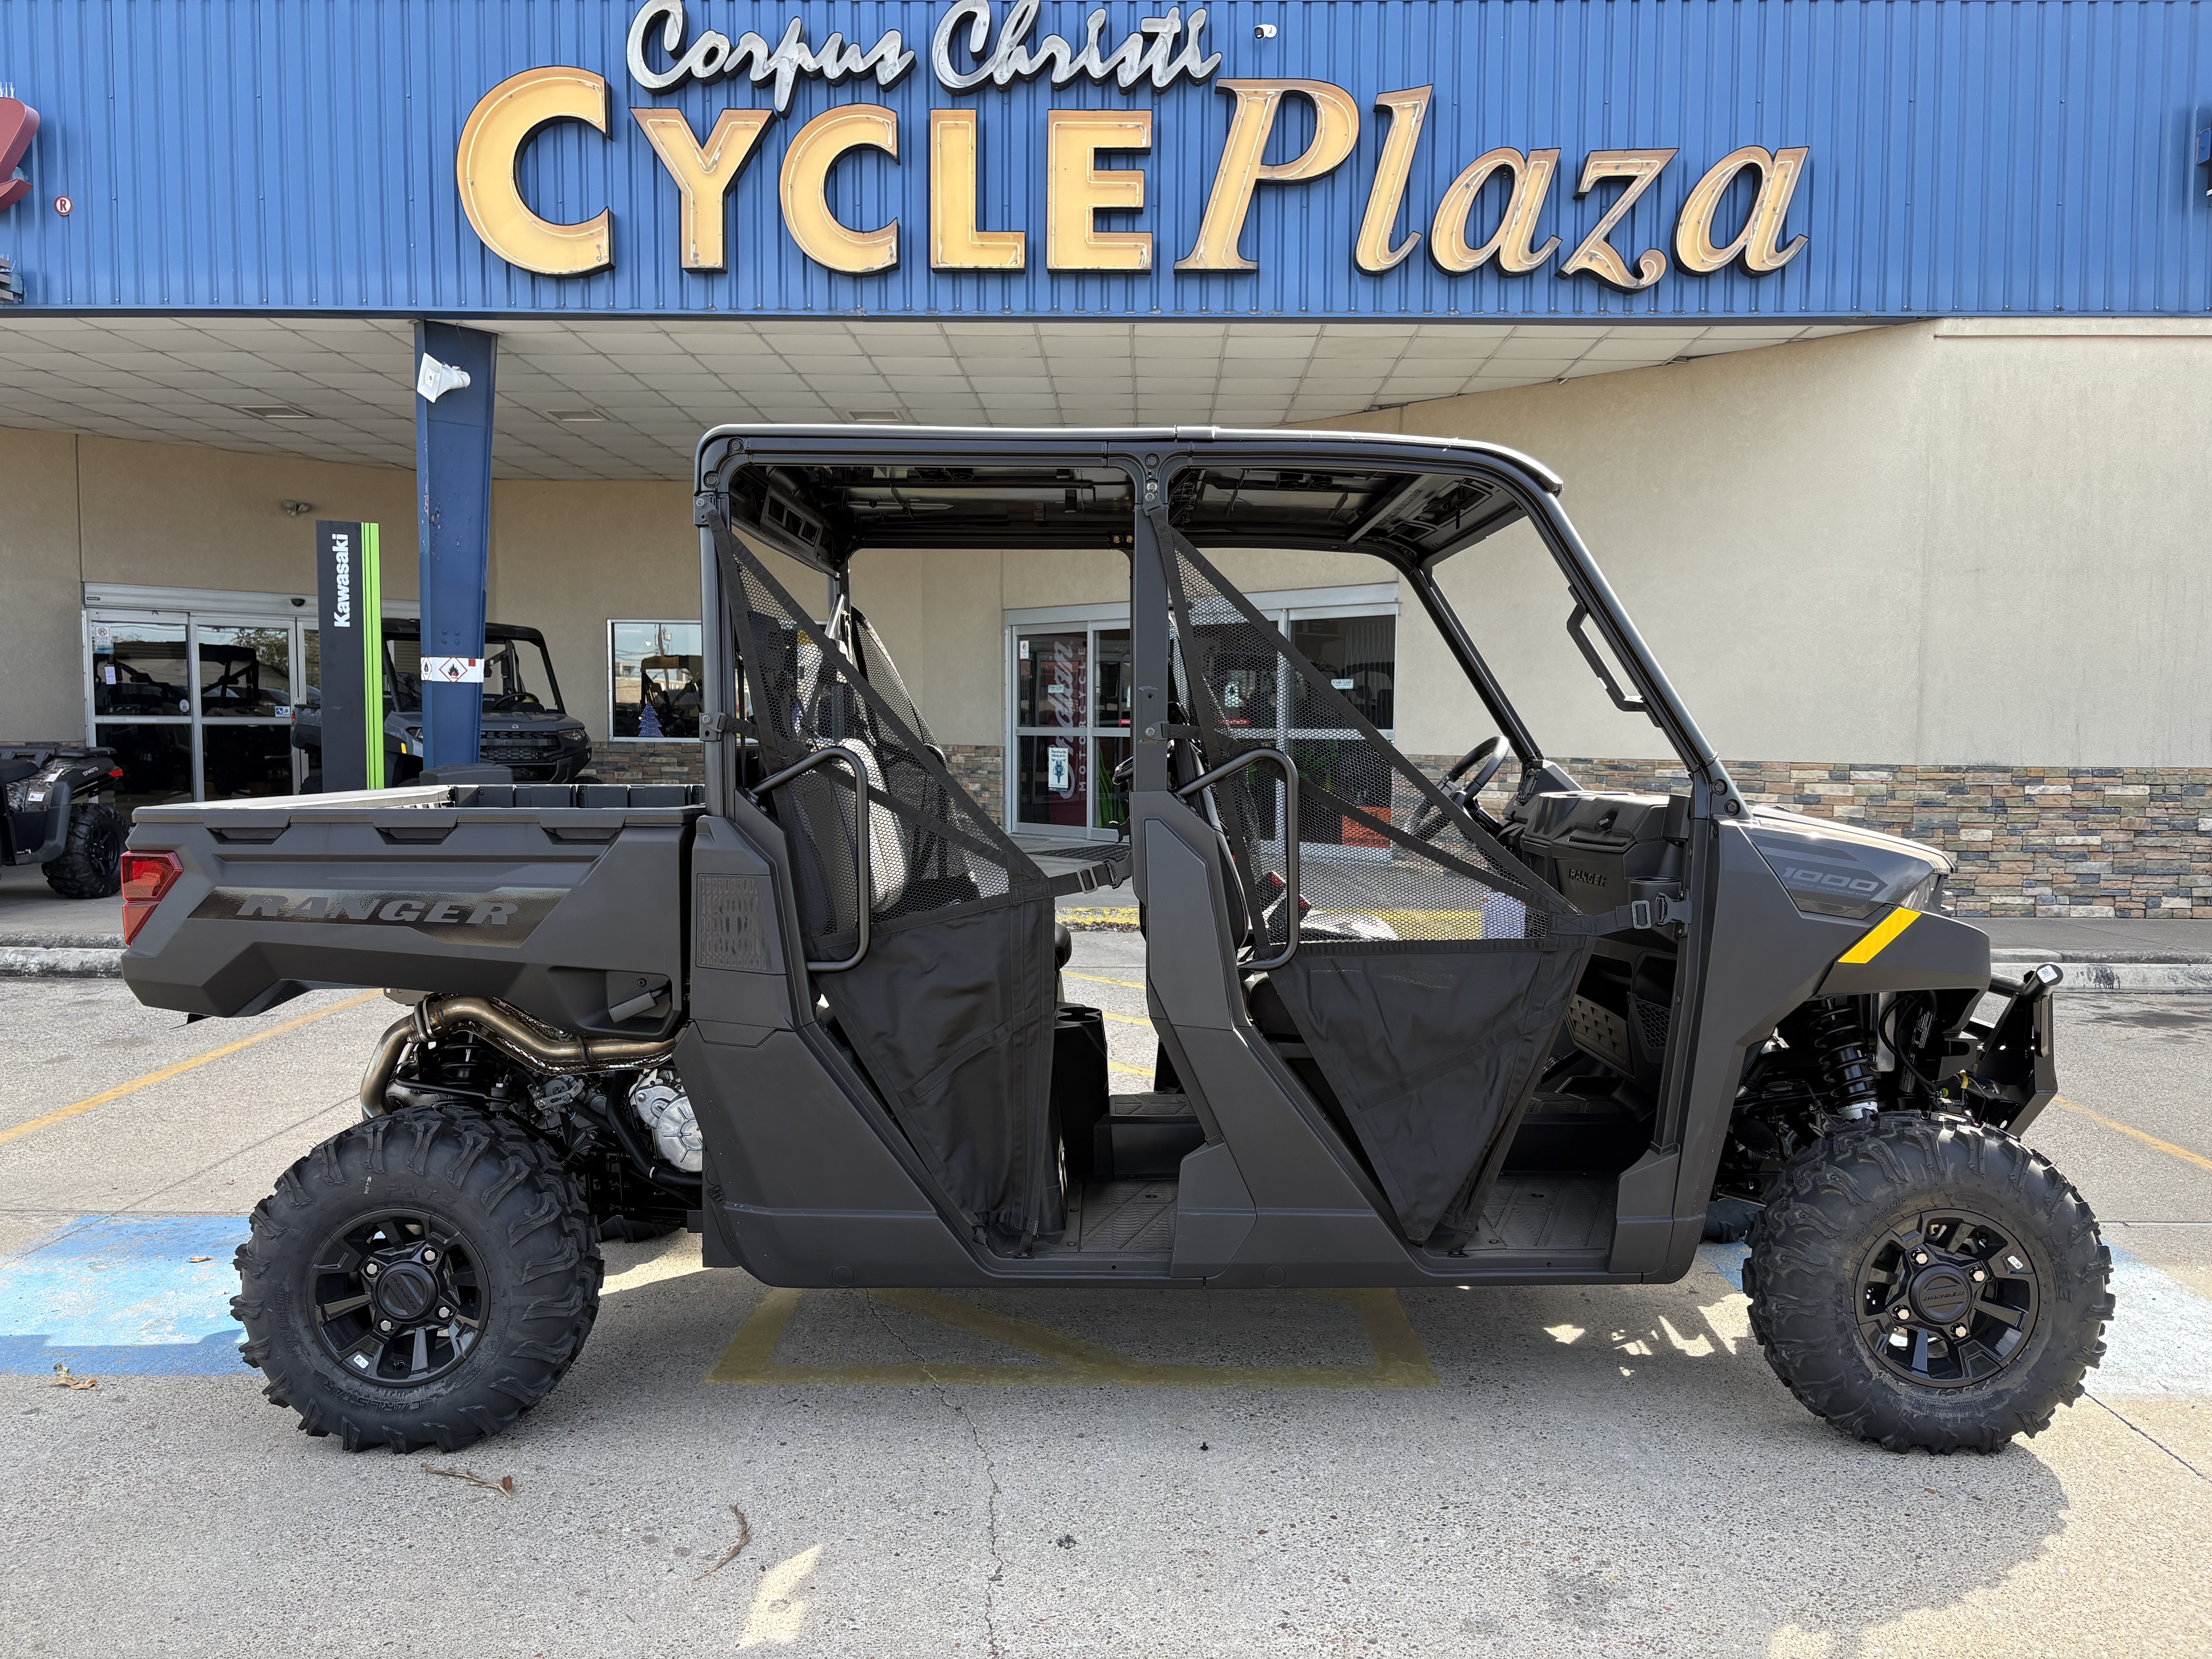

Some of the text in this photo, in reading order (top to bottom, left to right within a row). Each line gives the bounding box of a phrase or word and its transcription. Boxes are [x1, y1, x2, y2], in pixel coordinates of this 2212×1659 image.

[627, 0, 1222, 118] Corpus Christi
[457, 65, 1810, 294] CYCLE Plaza
[332, 534, 350, 627] Kawasaki
[1078, 648, 1086, 792] MOTORCYCLE
[1568, 868, 1607, 887] RANGER
[1783, 867, 1879, 891] 1000
[1817, 886, 1855, 895] OVERHEAD
[236, 895, 518, 925] RANGER
[1922, 1291, 1964, 1301] RANGER
[322, 1379, 422, 1413] CARLSTAR
